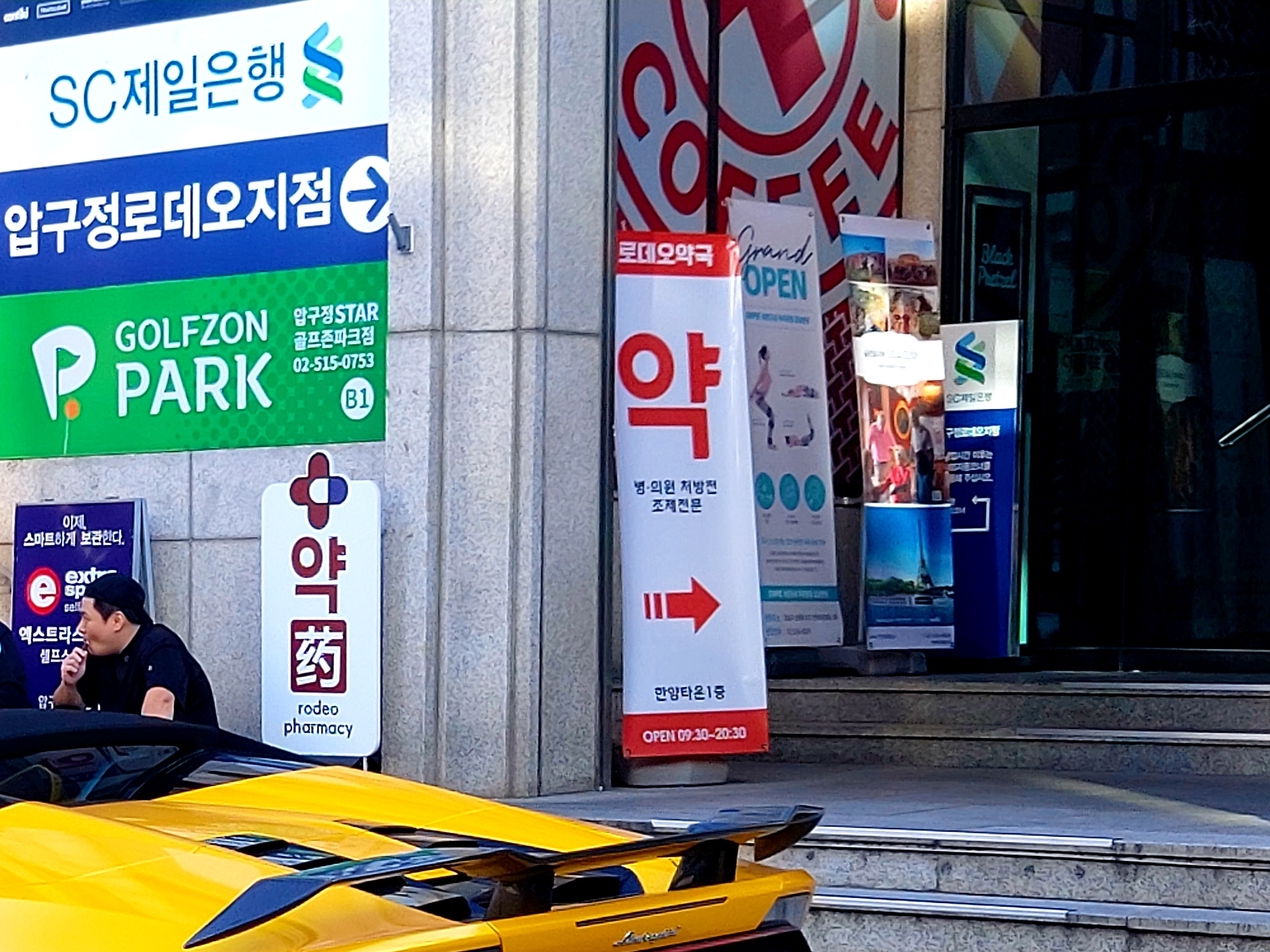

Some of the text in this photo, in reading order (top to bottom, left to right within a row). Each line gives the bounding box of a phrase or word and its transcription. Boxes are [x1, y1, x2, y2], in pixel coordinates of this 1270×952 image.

[49, 42, 286, 128] SC제일은행
[4, 167, 332, 258] 압구정로데오지점
[618, 240, 714, 267] 로데오약국
[743, 264, 807, 300] OPEN
[293, 302, 379, 326] 압구정STAR
[115, 309, 268, 353] GOLFZON
[293, 325, 375, 351] 골프존파크점
[293, 352, 375, 373] 02-515-0753
[115, 352, 273, 418] PARK
[618, 331, 721, 460] 약
[345, 388, 370, 409] B1
[680, 479, 718, 495] 처방전
[651, 498, 702, 513] 조제전문
[23, 529, 126, 547] 스마트하게 보관한다.
[291, 536, 347, 614] 약
[294, 625, 345, 689] 药
[298, 700, 339, 716] rodeo
[284, 718, 353, 739] pharmacy
[642, 729, 676, 743] OPEN
